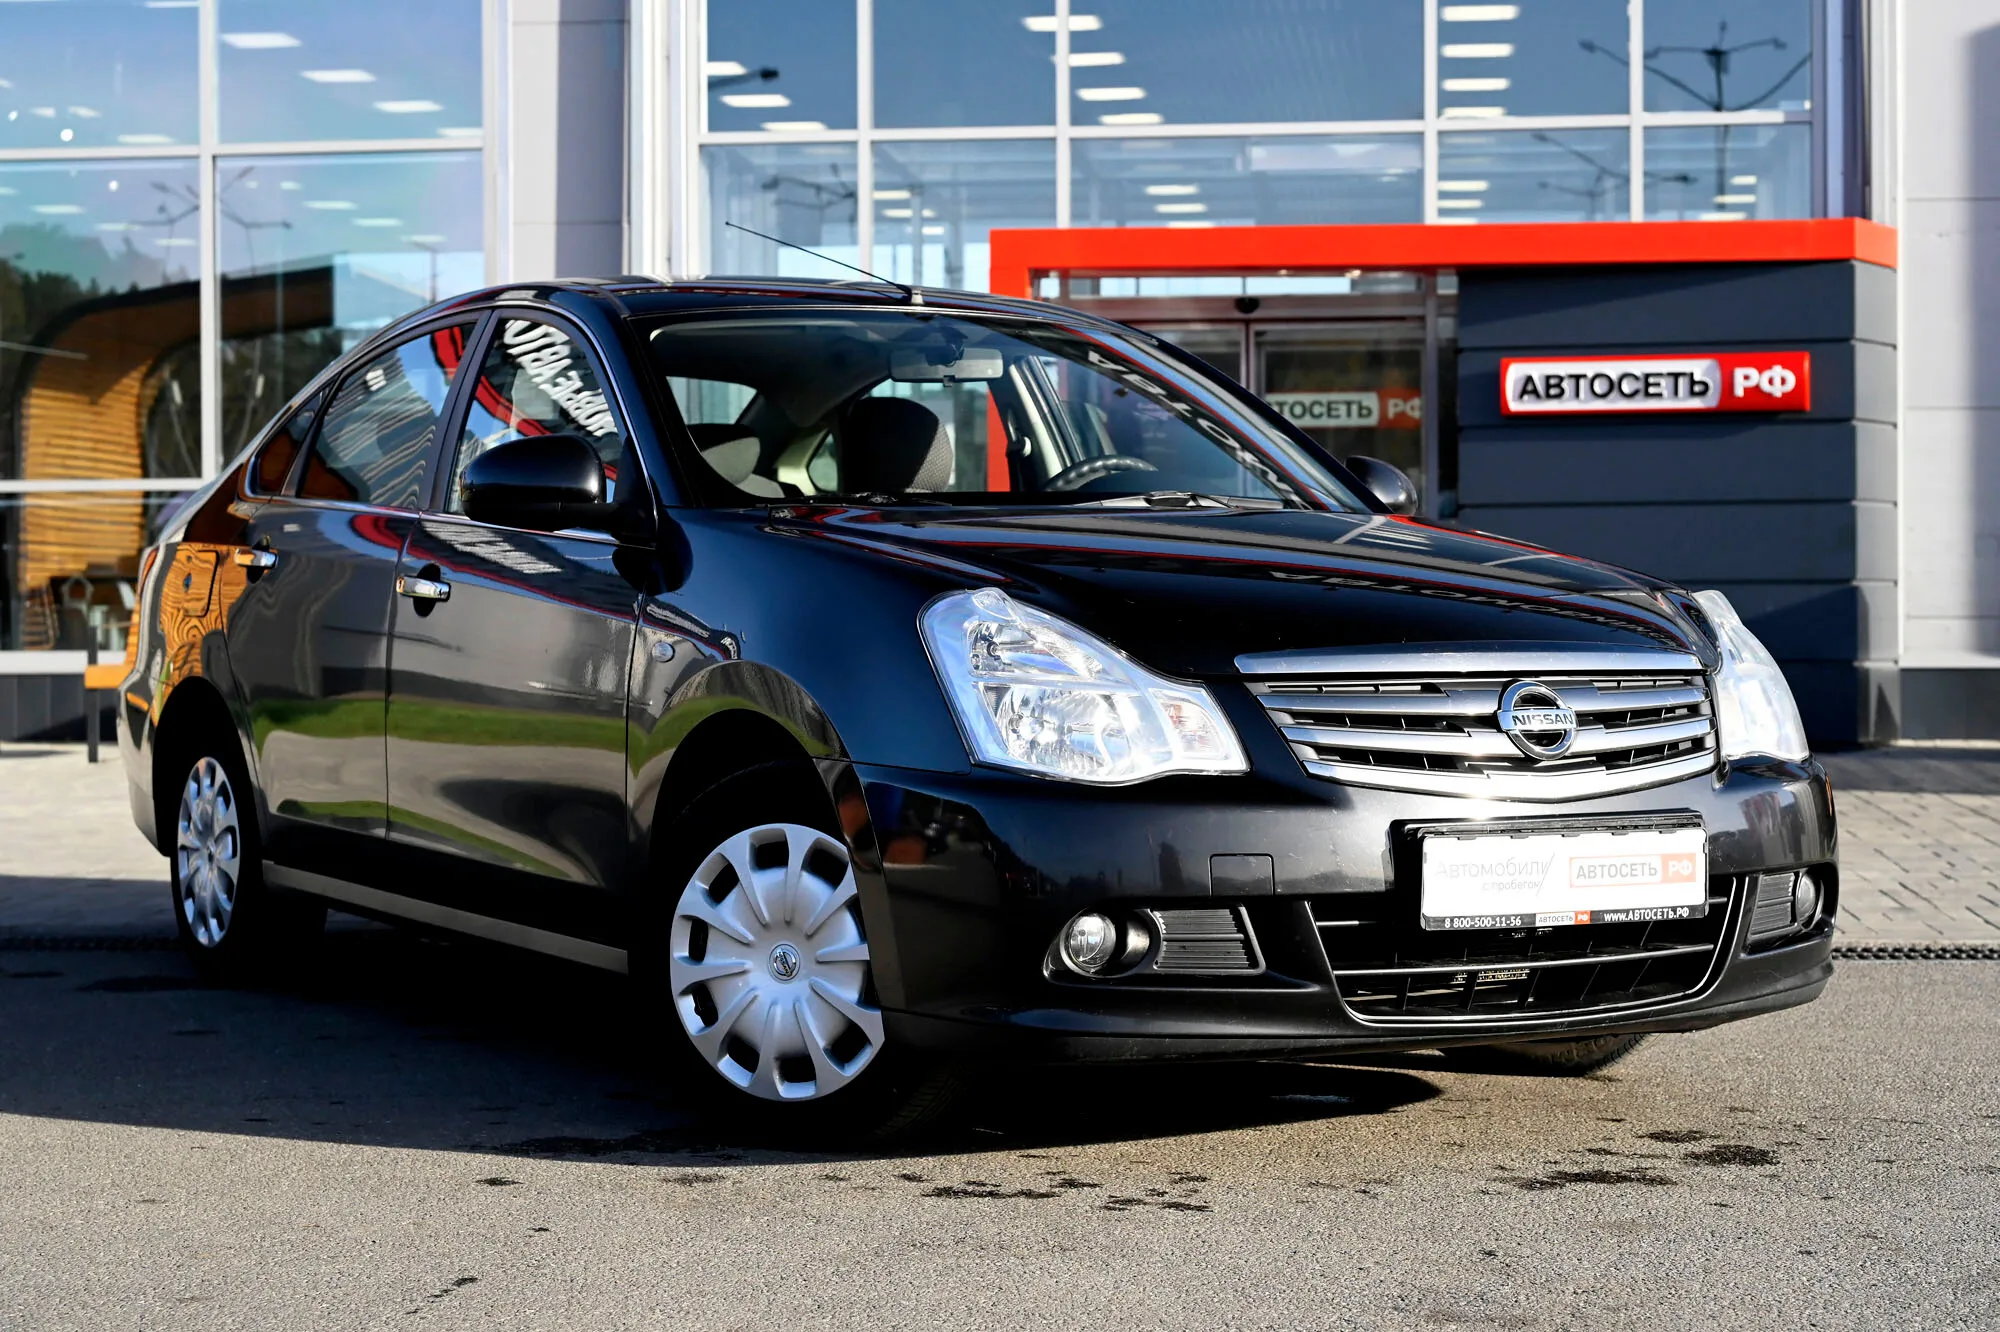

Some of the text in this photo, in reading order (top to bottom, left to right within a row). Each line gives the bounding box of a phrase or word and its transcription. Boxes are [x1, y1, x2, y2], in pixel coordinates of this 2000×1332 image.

[1519, 364, 1797, 400] АВТОСЕТЬ РФ
[1268, 400, 1374, 420] ТОСЕТЬ
[1511, 713, 1575, 726] NISSAN
[1576, 859, 1693, 880] АВТОСЕТЬ РФ
[1444, 915, 1522, 928] 8 800-500-11-56
[1538, 913, 1589, 923] АВТОСЕТЬ РФ
[1603, 906, 1690, 922] www.АВТОСЕТЬ.РФ
